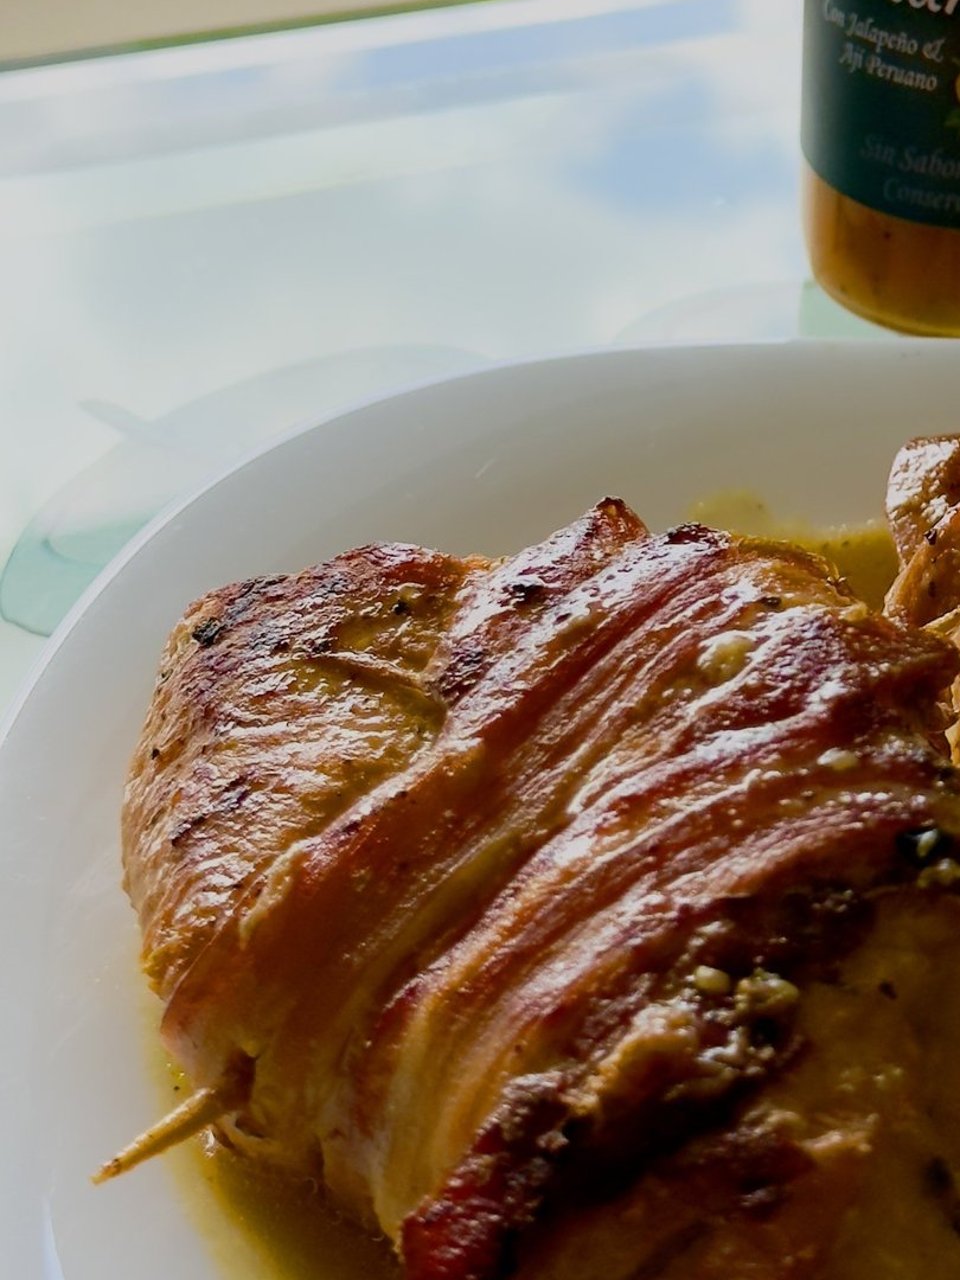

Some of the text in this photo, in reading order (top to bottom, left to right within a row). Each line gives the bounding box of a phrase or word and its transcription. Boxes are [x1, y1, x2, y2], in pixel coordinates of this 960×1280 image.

[845, 12, 919, 55] Jalapeño
[921, 35, 947, 64] &
[866, 53, 938, 93] Peruano
